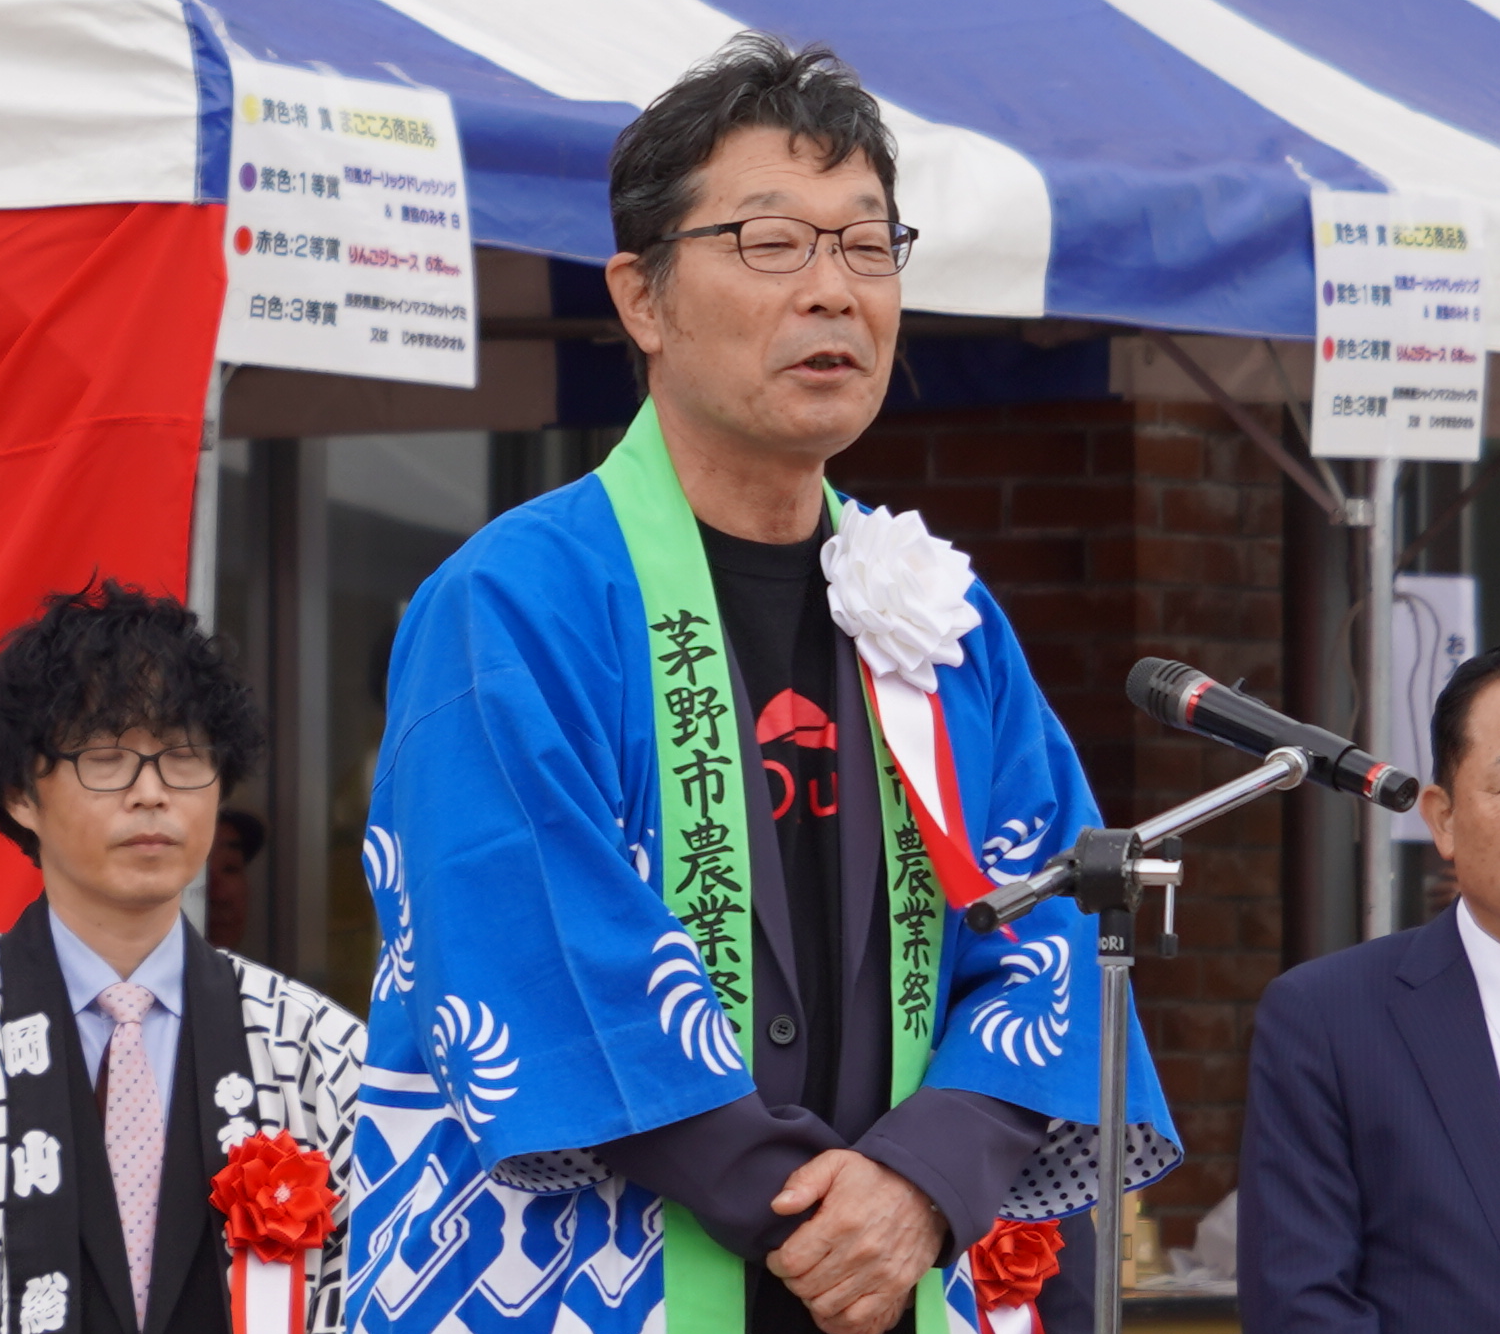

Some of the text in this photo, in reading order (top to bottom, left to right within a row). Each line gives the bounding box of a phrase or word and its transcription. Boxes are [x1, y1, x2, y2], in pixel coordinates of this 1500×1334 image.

[255, 230, 341, 262] 赤色:2等賞
[348, 245, 419, 271] りんごジュース
[250, 294, 338, 326] 白色:3等賞
